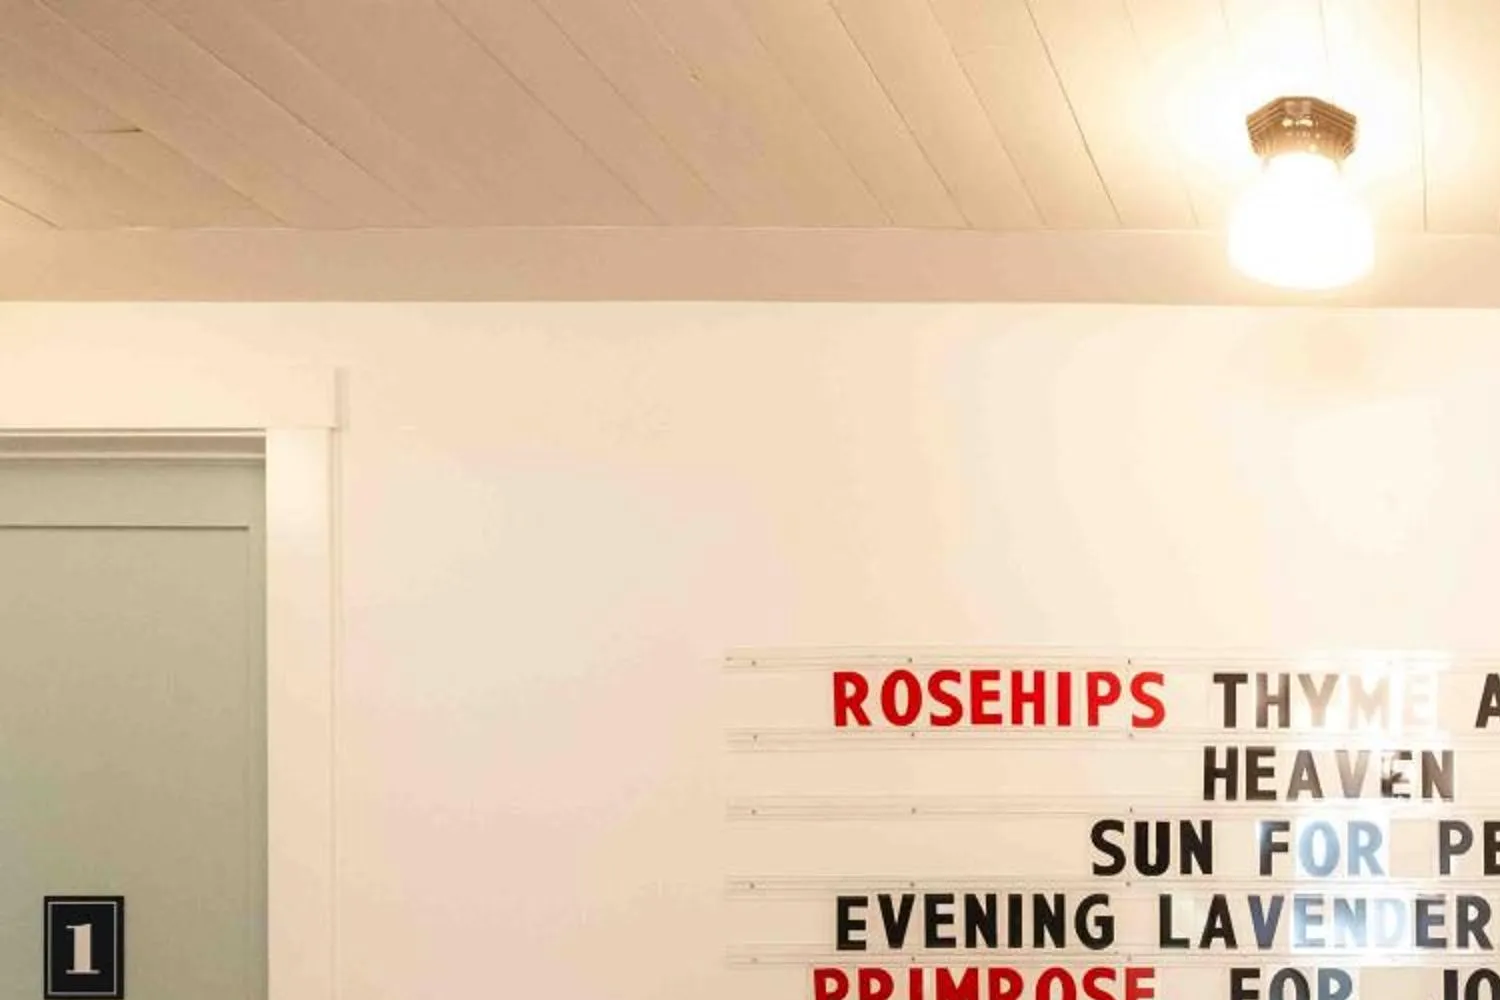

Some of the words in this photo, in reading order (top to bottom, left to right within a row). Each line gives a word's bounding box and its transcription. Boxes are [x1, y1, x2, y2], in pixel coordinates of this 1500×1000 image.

[833, 669, 1166, 729] ROSEHIPS
[1213, 672, 1427, 729] THYME
[1203, 746, 1455, 801] HEAVEN
[1090, 819, 1214, 877] SUN
[1259, 820, 1385, 877] FOR
[65, 923, 101, 975] 1
[835, 893, 1116, 951] EVENING
[1158, 894, 1494, 951] LAVENDER
